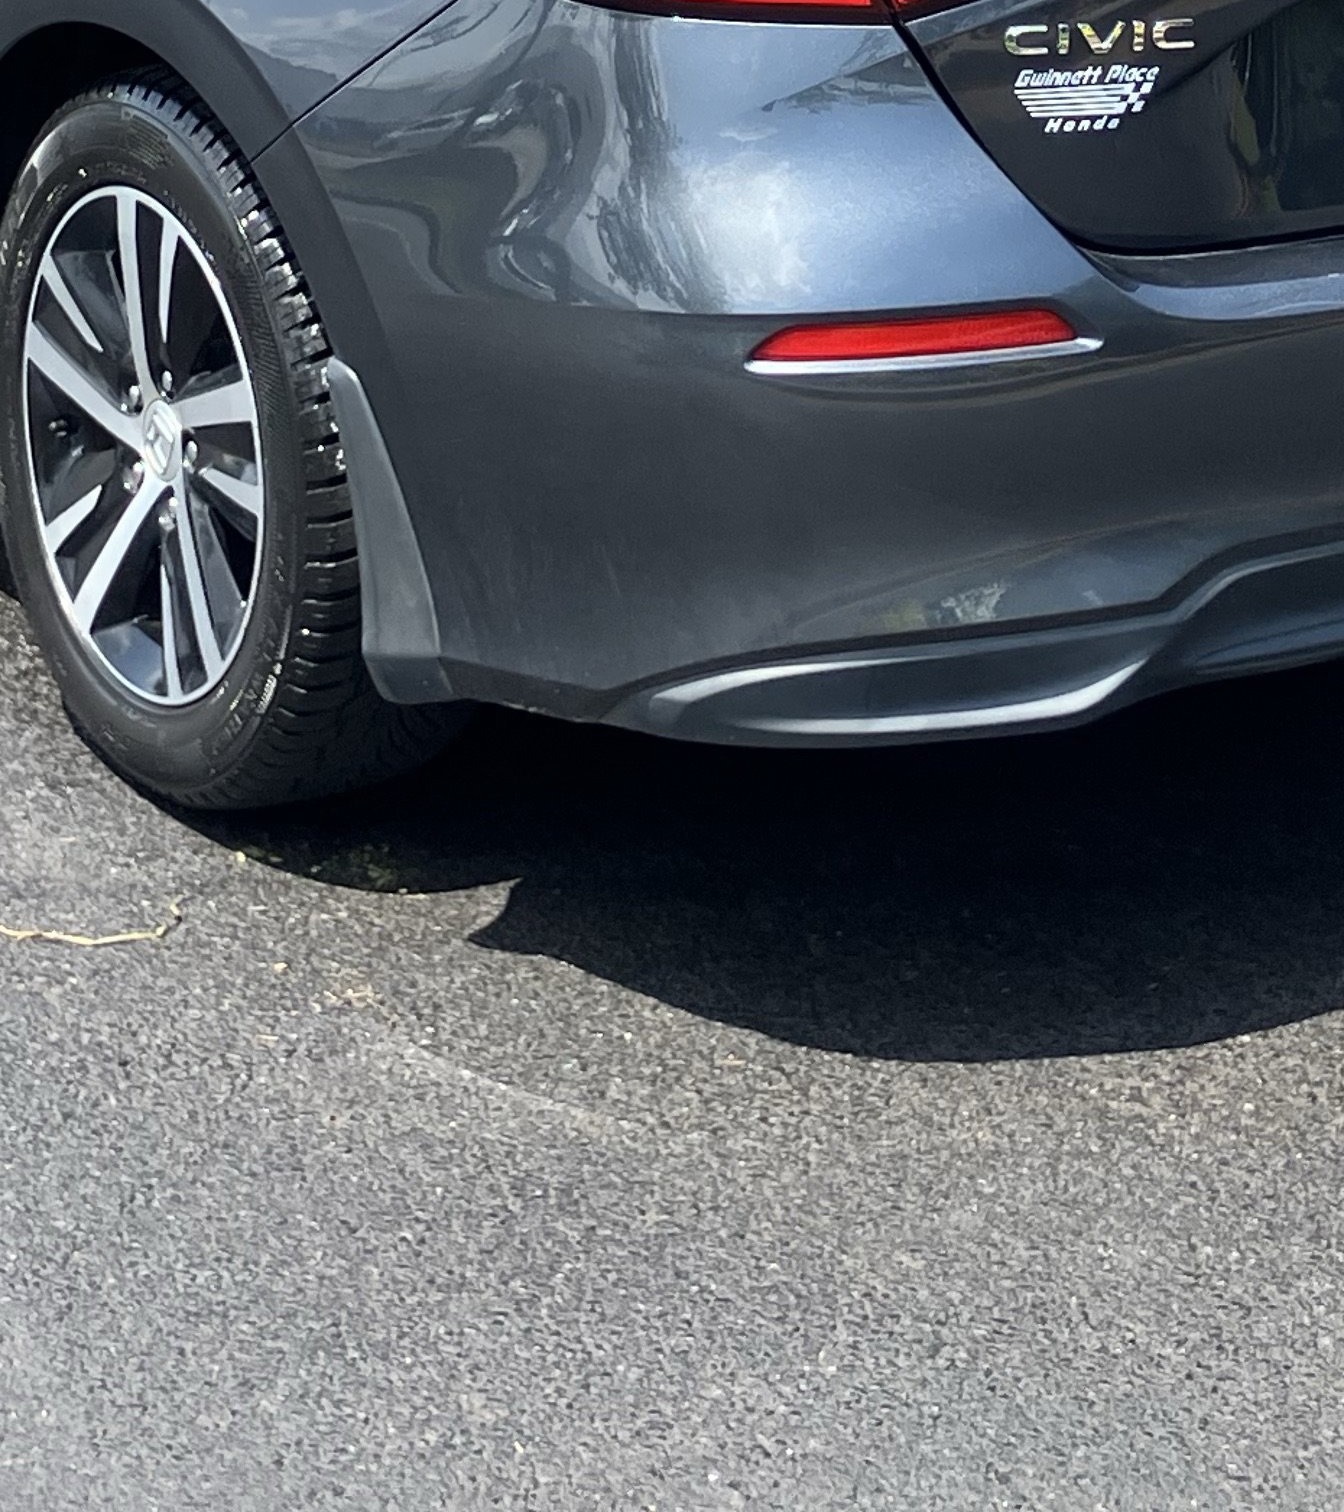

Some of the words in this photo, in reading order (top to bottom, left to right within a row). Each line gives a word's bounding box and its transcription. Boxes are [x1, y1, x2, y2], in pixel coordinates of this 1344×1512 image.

[1003, 18, 1196, 56] CIVIC
[1014, 65, 1103, 88] Gwinnett
[1104, 64, 1160, 83] Place
[1044, 114, 1121, 134] Honda
